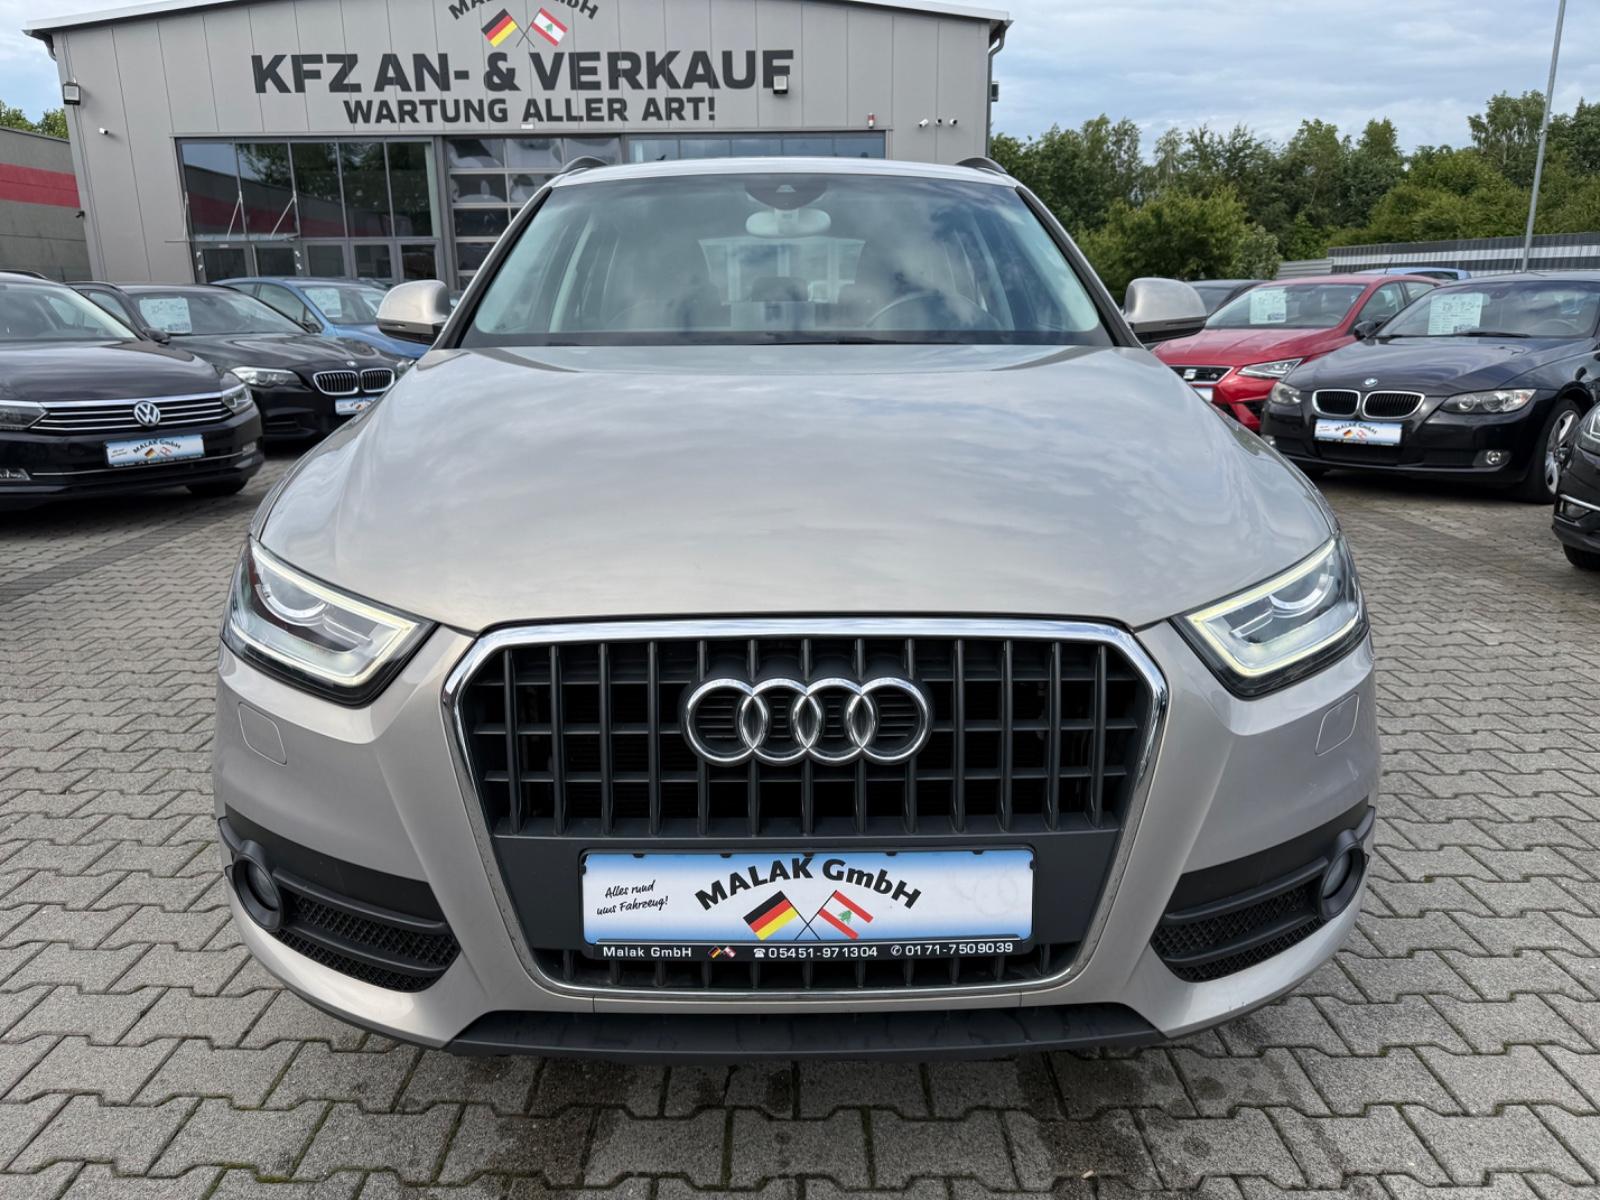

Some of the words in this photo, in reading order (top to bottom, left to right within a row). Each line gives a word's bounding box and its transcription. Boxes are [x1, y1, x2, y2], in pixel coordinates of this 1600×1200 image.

[251, 54, 362, 94] KFZ
[373, 53, 470, 92] AN-
[483, 52, 522, 92] &
[528, 50, 794, 91] VERKAUF
[343, 98, 508, 124] WARTUNG
[521, 98, 628, 122] ALLER
[641, 96, 716, 121] ART!
[605, 885, 629, 899] Alles
[631, 879, 656, 894] rund
[694, 857, 814, 911] MALAK
[822, 858, 922, 909] GmbH
[619, 895, 668, 911] Fahrzeug!
[603, 946, 645, 958] Malak
[650, 946, 691, 958] GmbH
